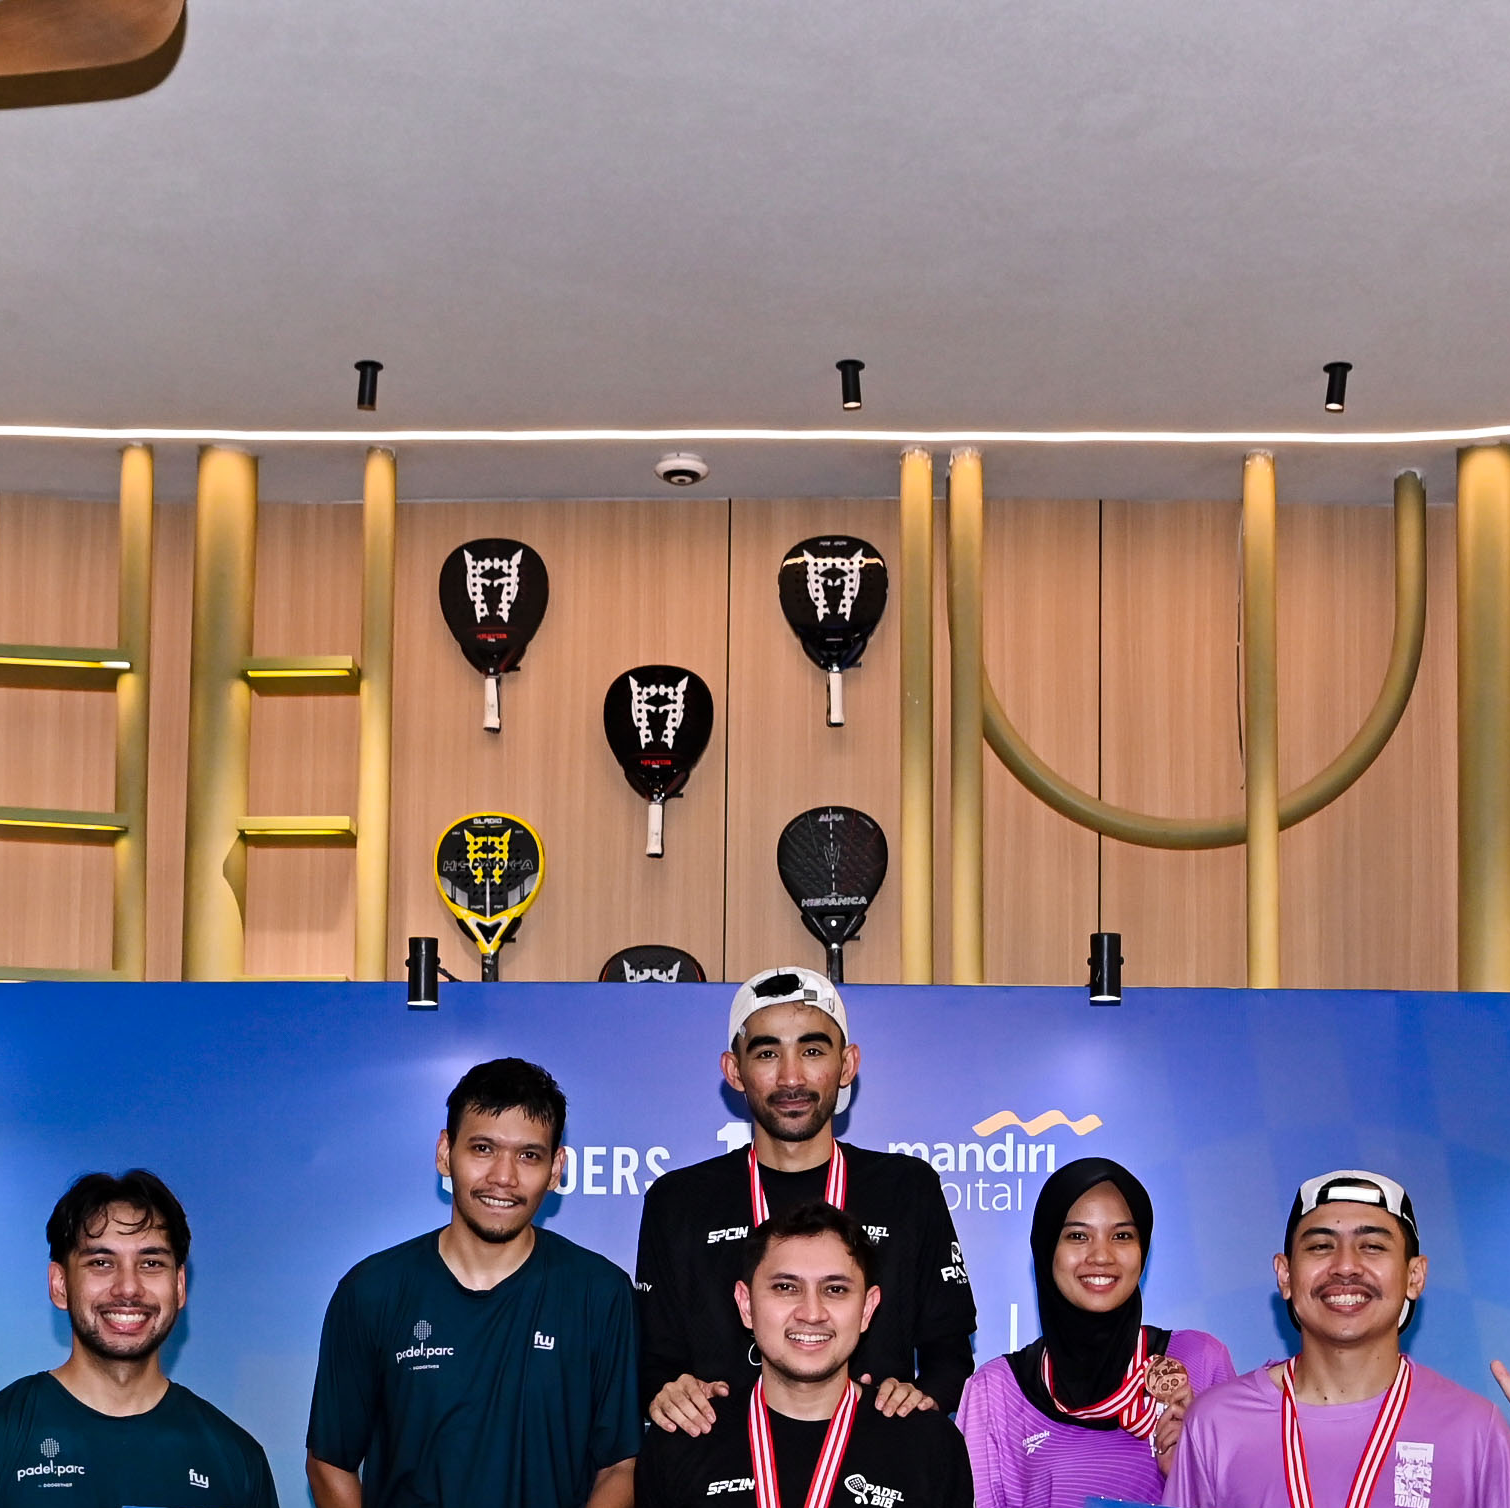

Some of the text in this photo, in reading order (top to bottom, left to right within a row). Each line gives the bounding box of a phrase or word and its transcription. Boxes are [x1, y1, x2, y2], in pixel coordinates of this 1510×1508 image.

[554, 1146, 670, 1195] OERS
[865, 1483, 904, 1502] PADEL
[871, 1495, 894, 1508] BIB
